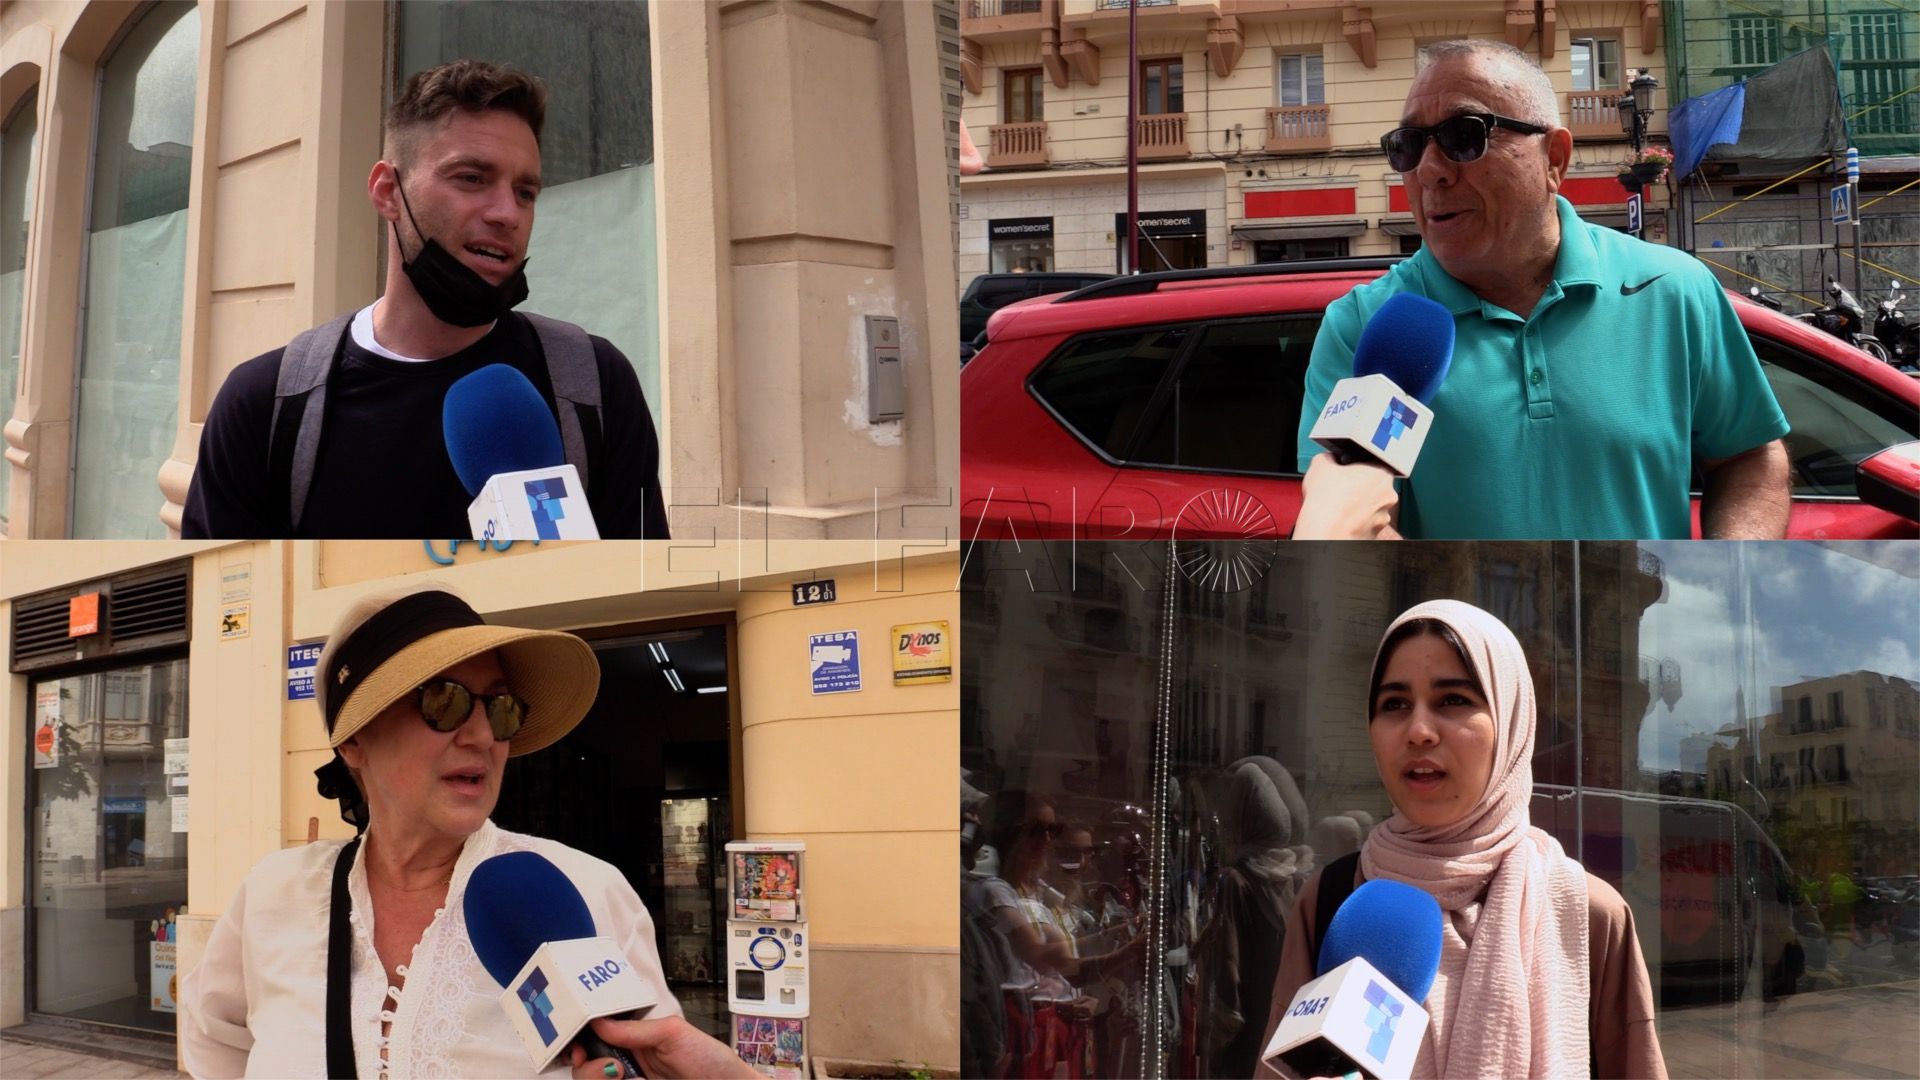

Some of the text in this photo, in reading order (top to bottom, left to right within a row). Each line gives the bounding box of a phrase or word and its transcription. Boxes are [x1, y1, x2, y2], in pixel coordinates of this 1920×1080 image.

[1136, 217, 1192, 228] omen'secret
[1629, 200, 1638, 229] P
[993, 223, 1050, 234] women'secret
[1323, 395, 1358, 421] FARO
[795, 584, 821, 603] 12
[810, 632, 858, 645] ITESA
[290, 647, 322, 662] ITES
[577, 958, 621, 992] FARO
